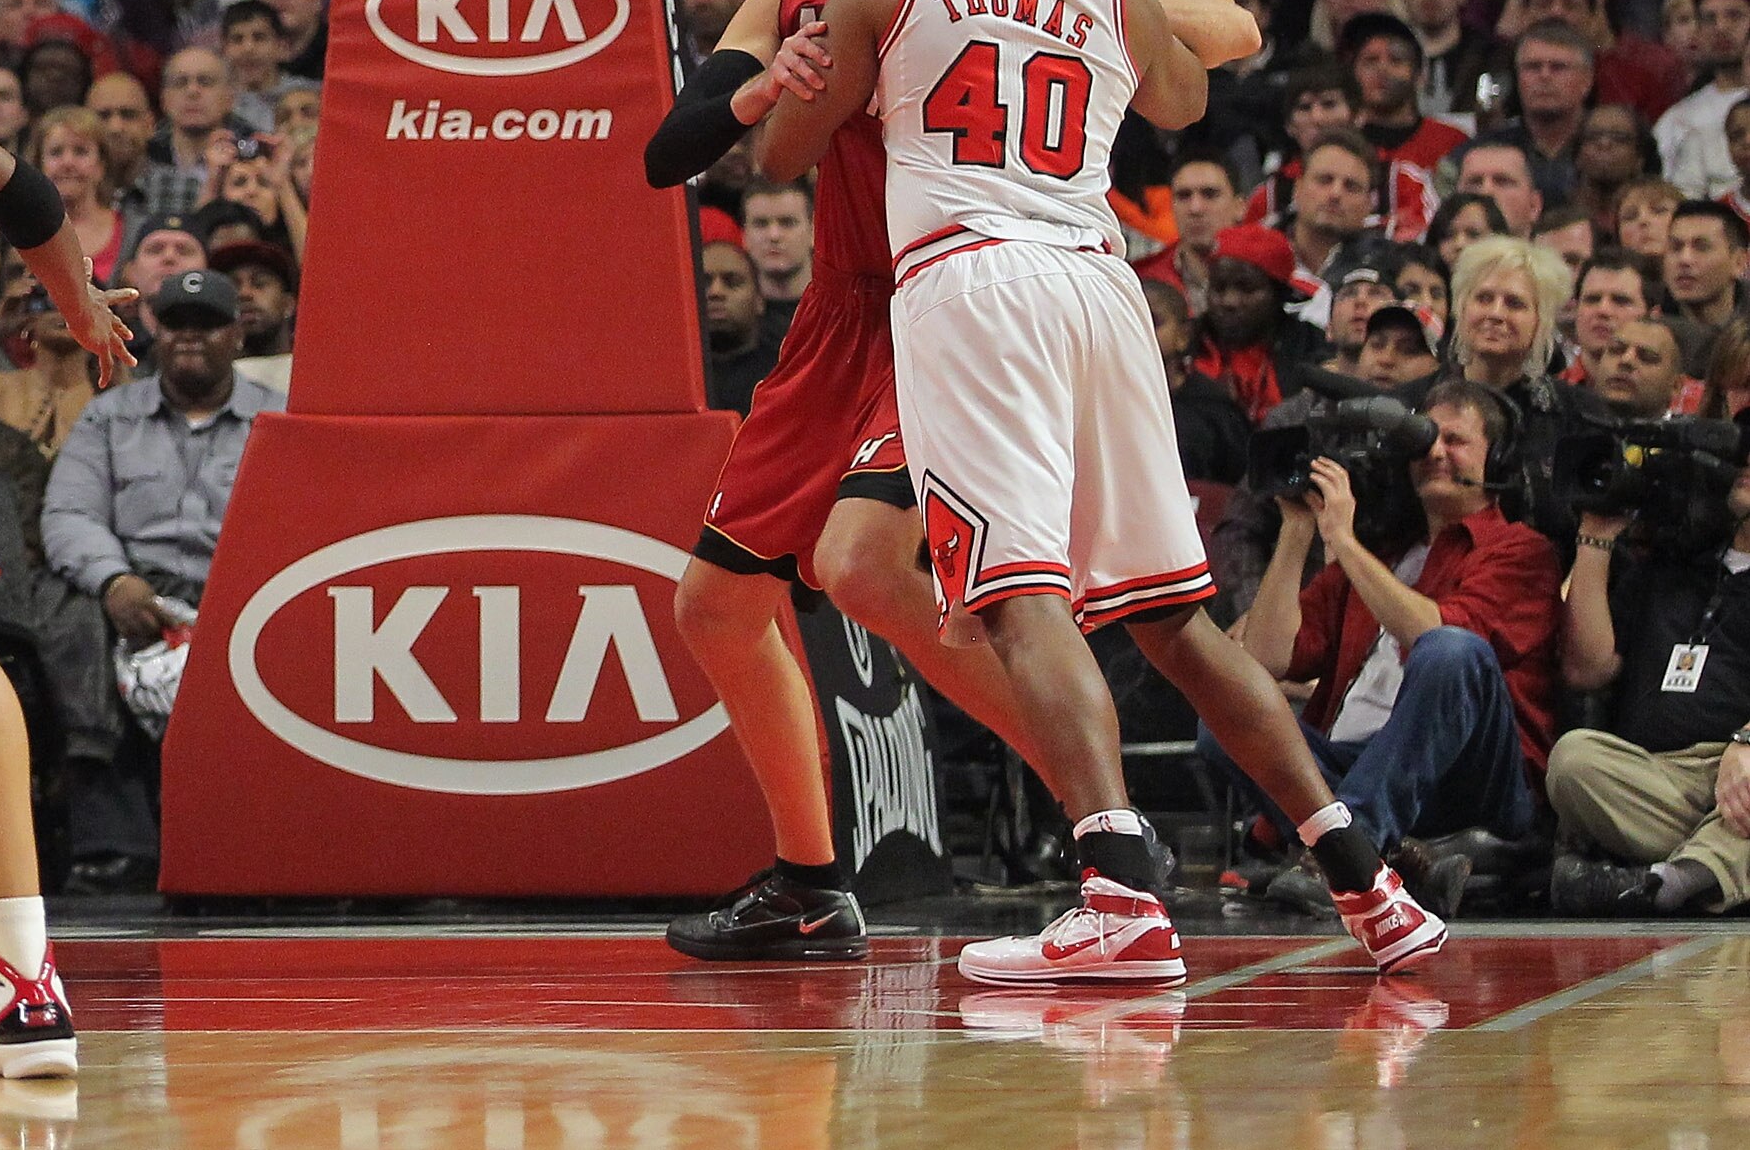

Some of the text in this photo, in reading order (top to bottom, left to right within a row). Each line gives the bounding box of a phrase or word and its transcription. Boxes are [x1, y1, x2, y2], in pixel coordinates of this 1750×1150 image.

[385, 99, 614, 141] kia.com
[922, 39, 1094, 181] 40
[181, 271, 205, 294] C
[327, 584, 681, 724] KIA
